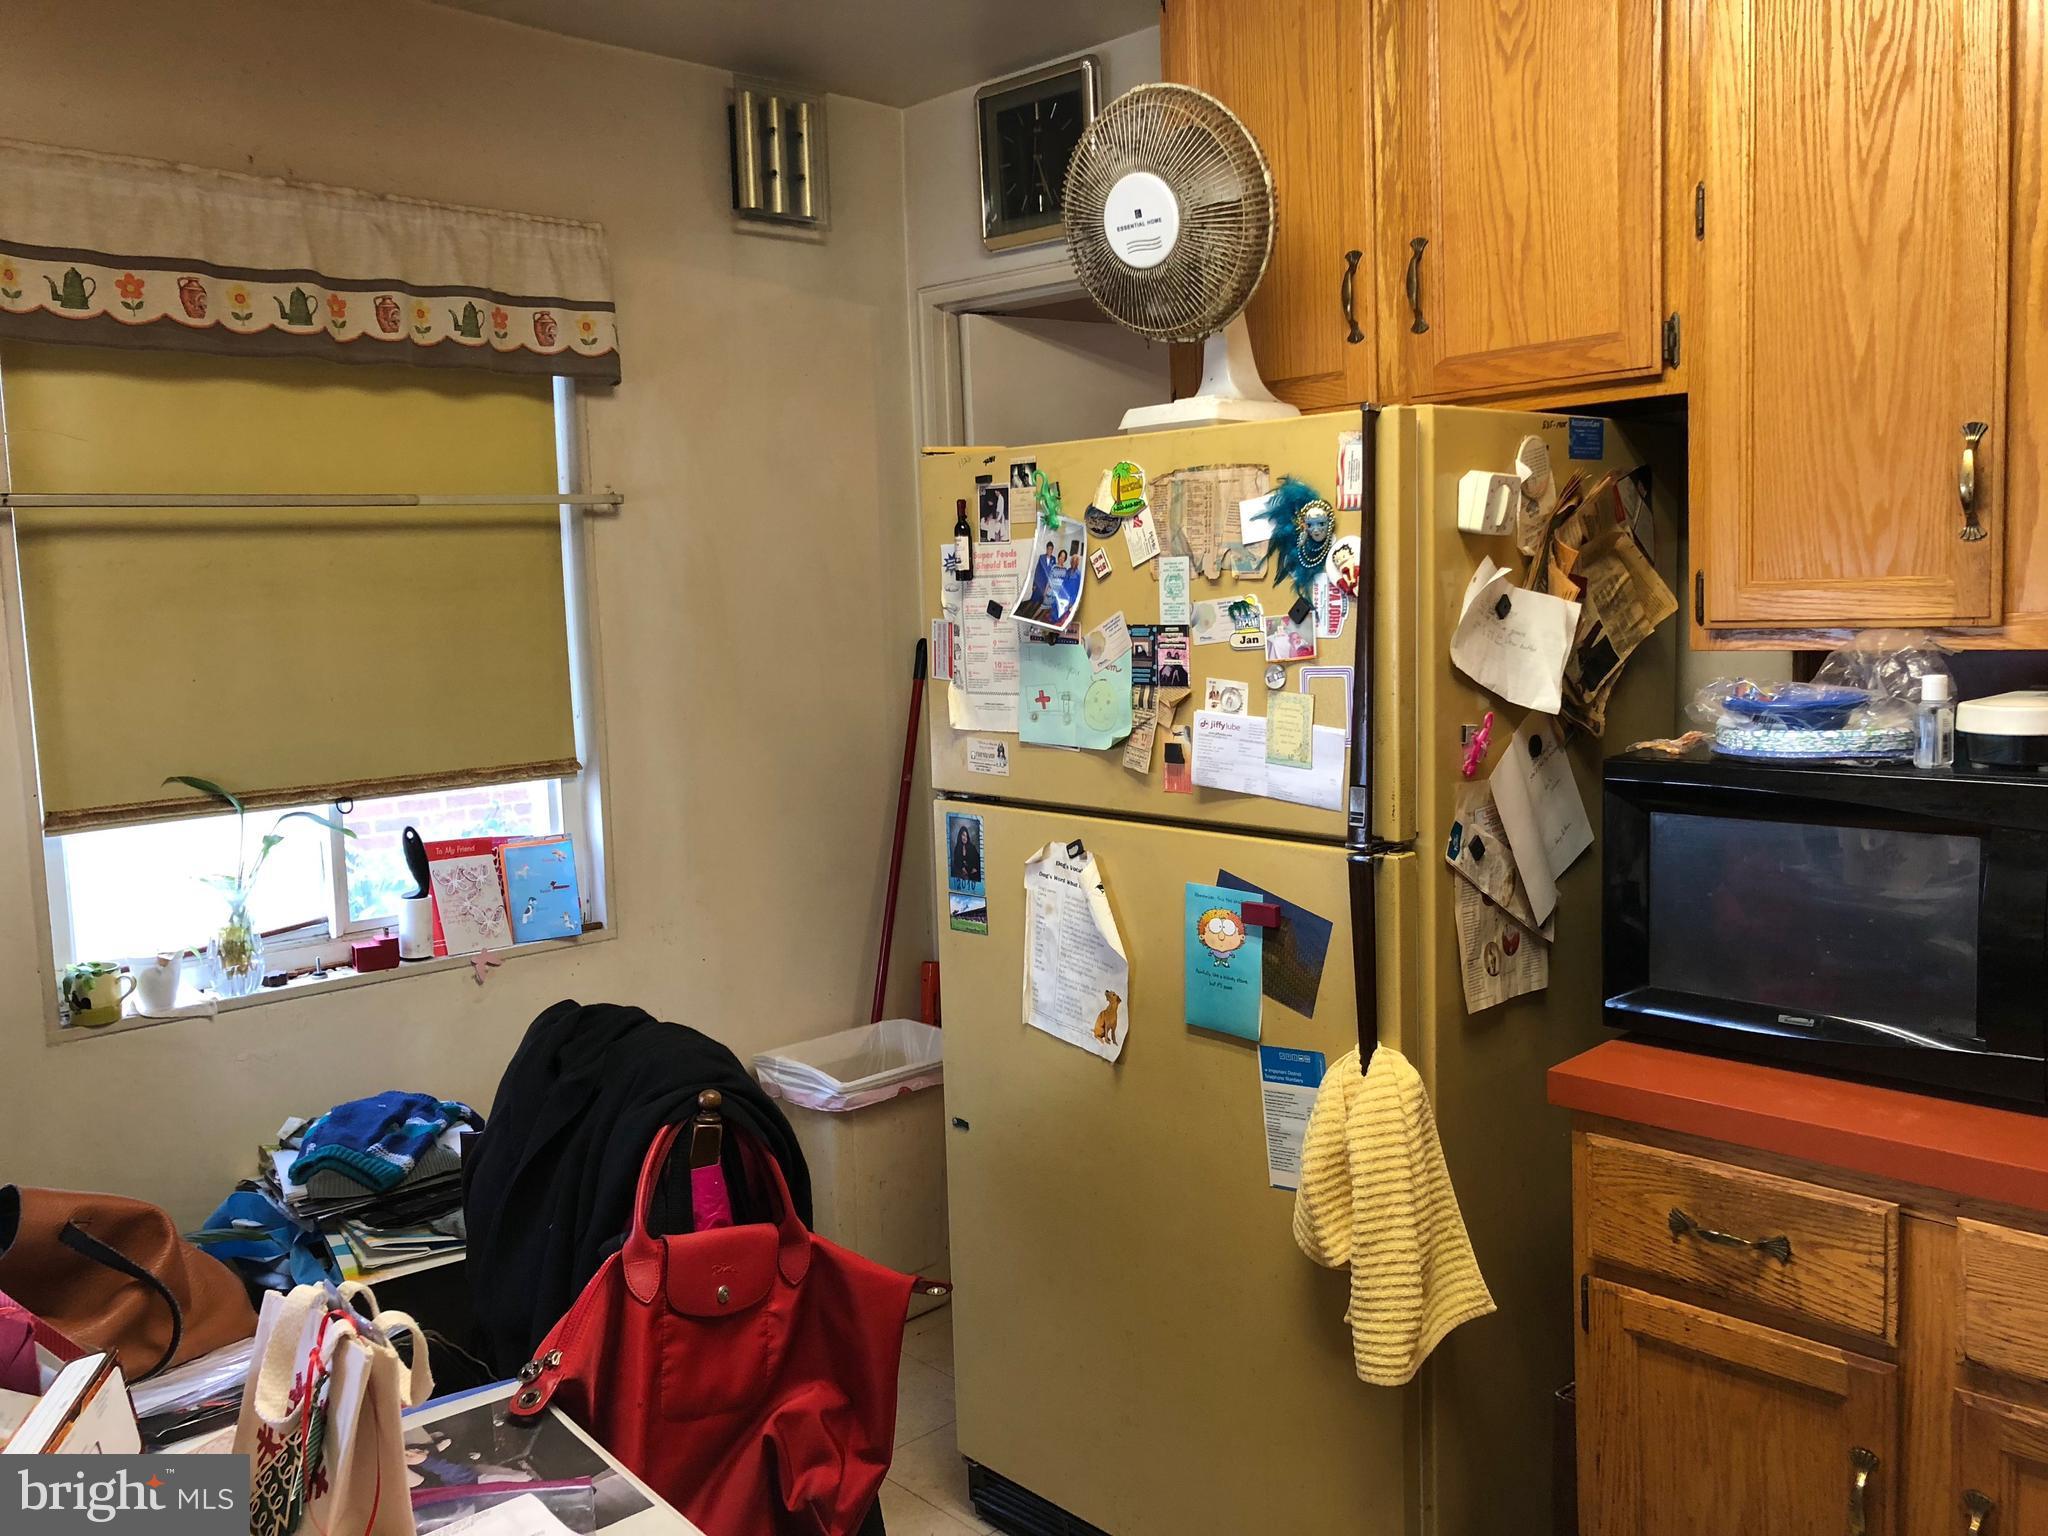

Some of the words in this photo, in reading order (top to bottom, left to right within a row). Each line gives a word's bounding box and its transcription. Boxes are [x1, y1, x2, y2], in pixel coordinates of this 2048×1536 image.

[1116, 222, 1145, 232] ESSENTIAL
[1146, 217, 1162, 225] HOME
[973, 552, 993, 561] Super
[996, 549, 1017, 558] Foods
[976, 560, 1001, 570] Should
[1003, 560, 1017, 569] Eat!
[1239, 635, 1259, 645] Jan
[435, 847, 443, 856] To
[444, 845, 456, 855] My
[456, 844, 476, 854] Friend
